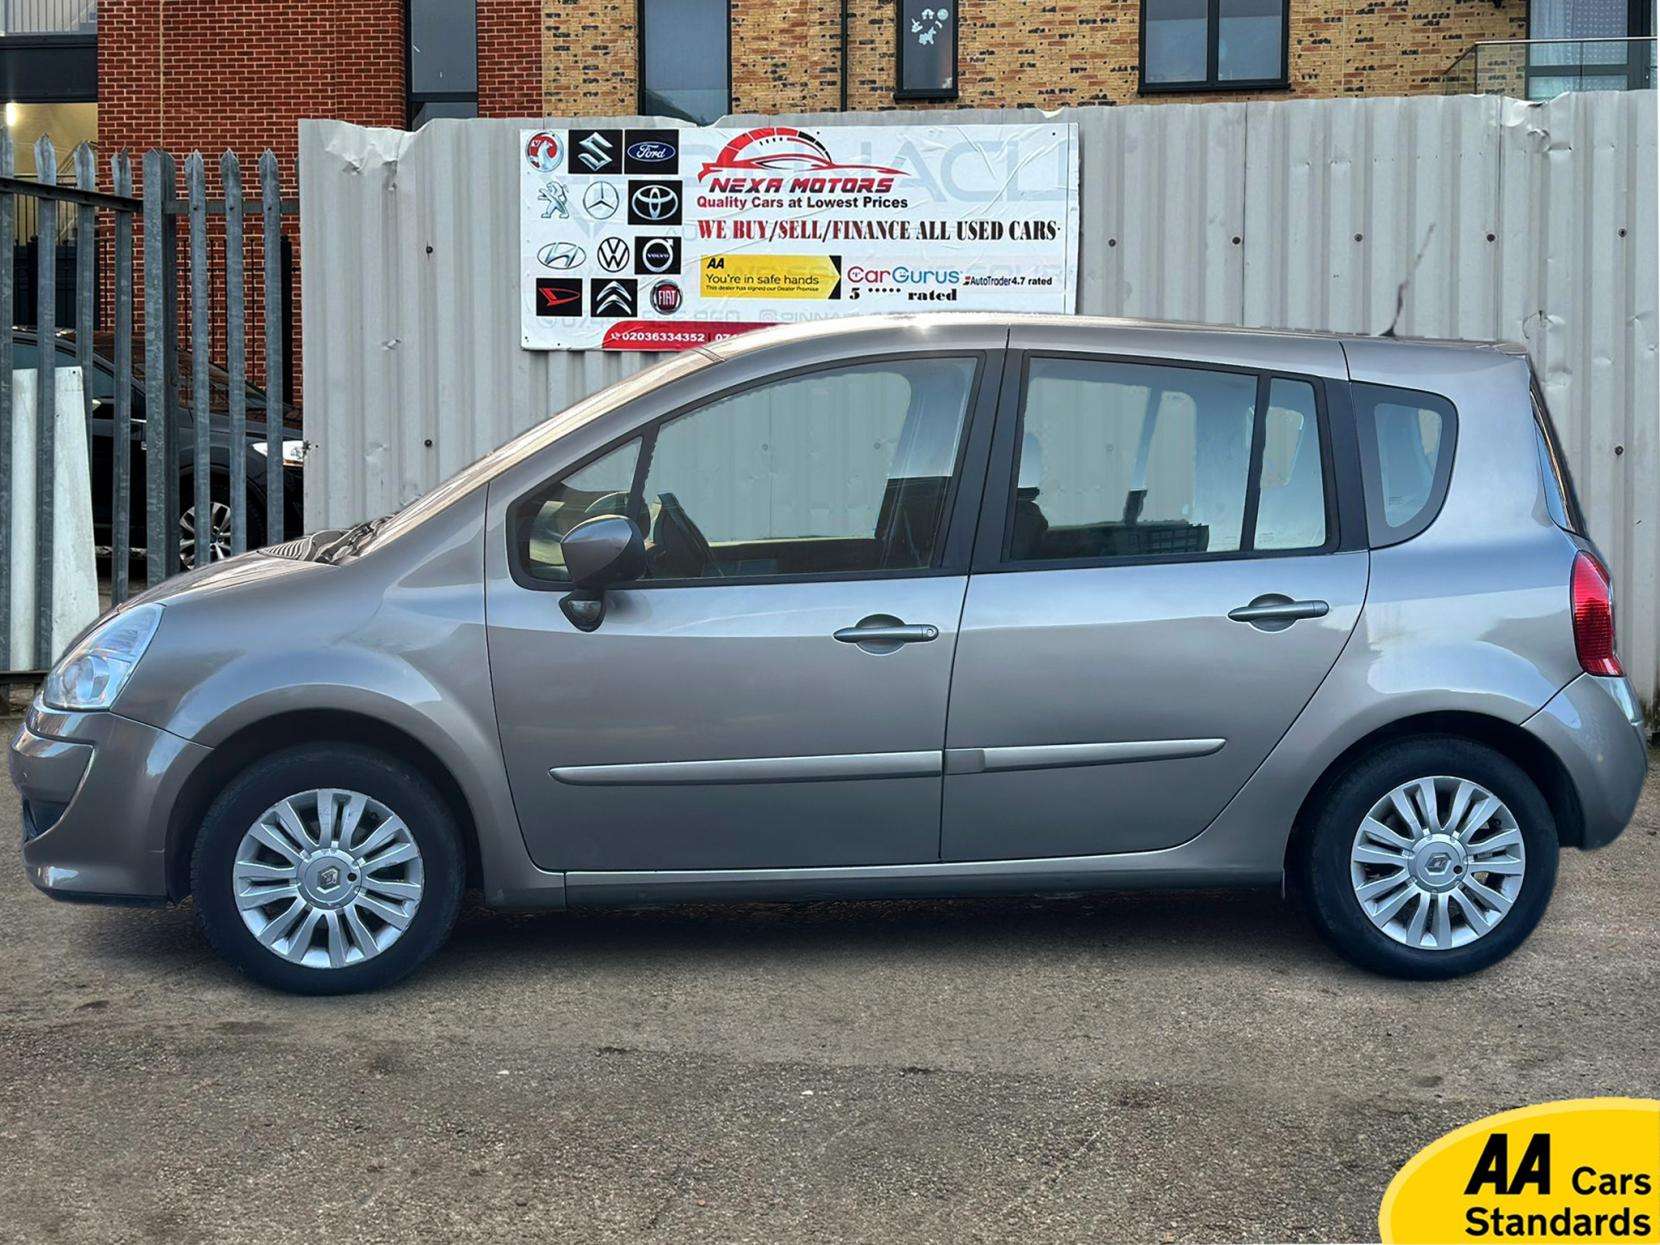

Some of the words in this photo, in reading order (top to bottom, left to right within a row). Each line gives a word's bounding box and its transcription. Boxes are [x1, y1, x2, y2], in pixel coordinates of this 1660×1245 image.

[636, 144, 666, 159] Ford
[709, 177, 784, 193] NEXA
[789, 177, 895, 193] MOTORS
[697, 195, 747, 210] Quality
[751, 196, 784, 208] Cars
[788, 196, 803, 208] at
[807, 196, 858, 208] Lowest
[863, 196, 908, 208] Prices
[697, 219, 727, 239] WE
[916, 220, 951, 240] ALL
[956, 220, 1004, 240] USED
[1008, 220, 1057, 240] CARS
[707, 257, 725, 269] AA
[705, 273, 741, 284] You're
[744, 273, 754, 284] in
[757, 273, 781, 285] safe
[784, 274, 820, 285] hands
[847, 266, 960, 284] CarGurus
[1028, 277, 1053, 286] rated
[658, 289, 677, 306] FIAT
[849, 287, 861, 301] 5
[908, 288, 958, 301] rated
[622, 333, 706, 342] 02036334352
